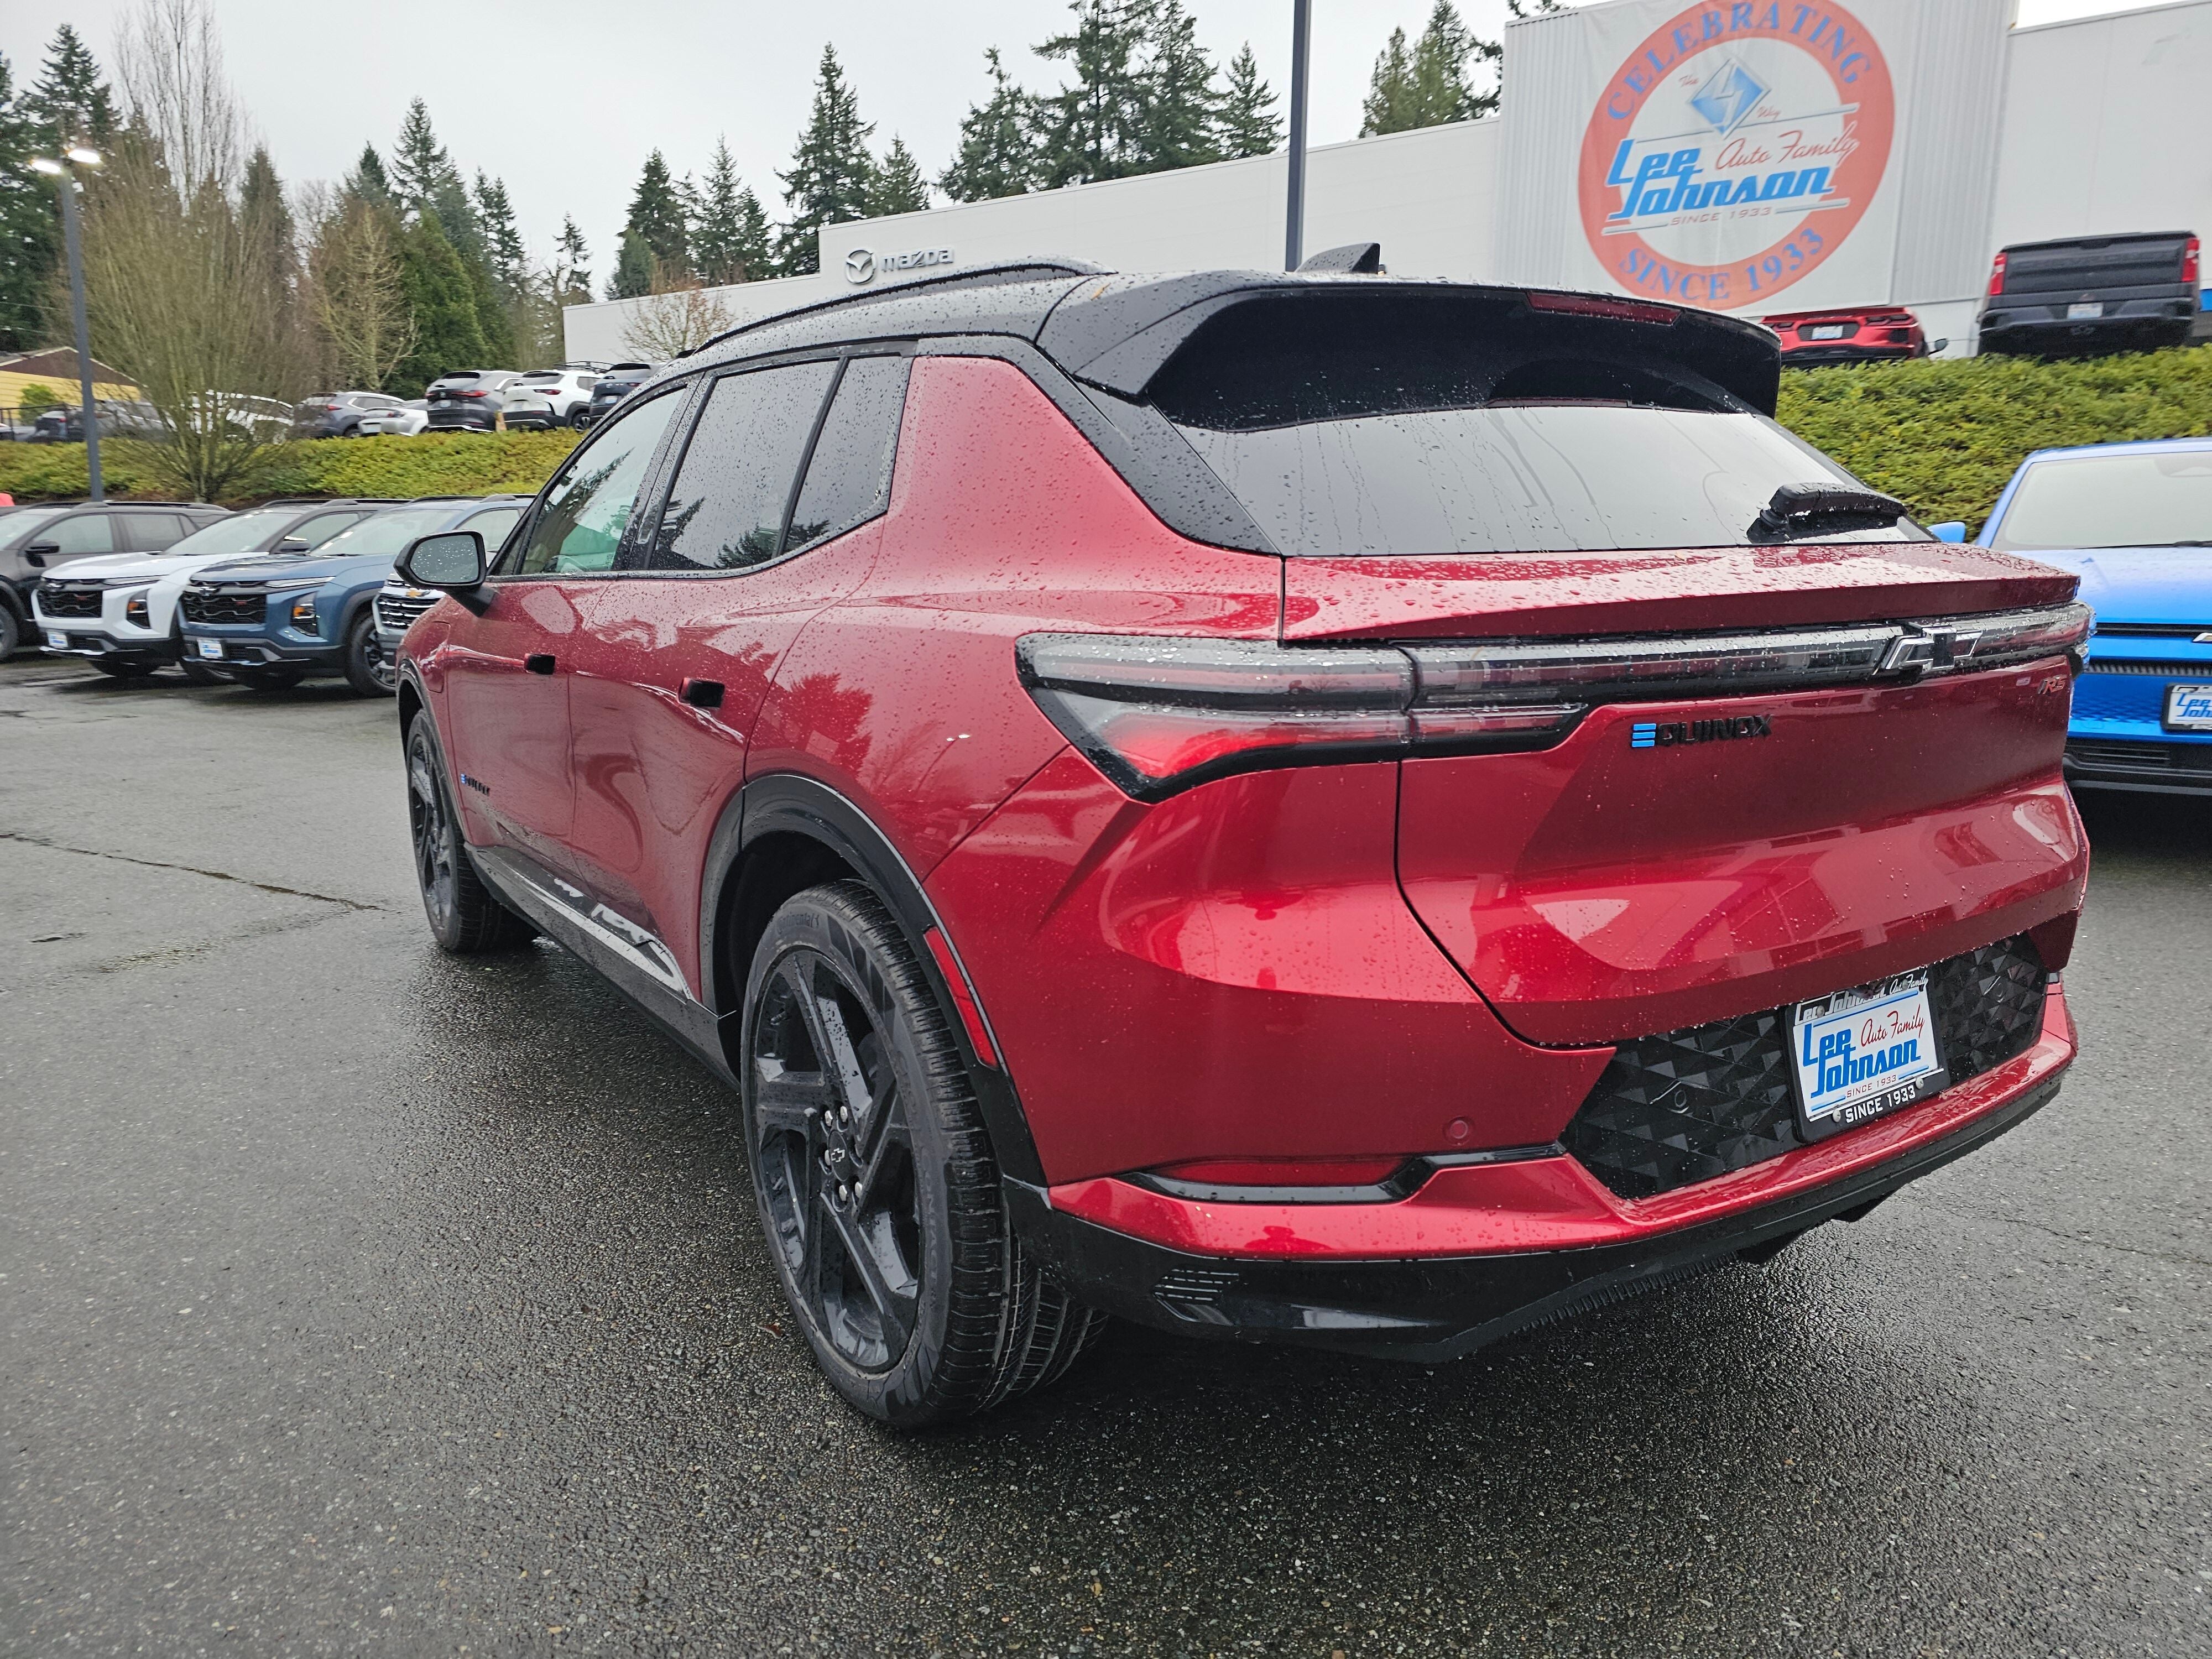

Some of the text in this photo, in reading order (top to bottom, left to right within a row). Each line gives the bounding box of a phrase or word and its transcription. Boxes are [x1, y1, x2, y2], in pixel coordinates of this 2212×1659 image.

[1607, 1, 1872, 120] CELEBRATING
[1608, 120, 1860, 185] Lee Auto Family
[1608, 165, 1837, 220] Johnson
[1670, 206, 1772, 226] SINCE 1933
[881, 248, 954, 272] mazda
[1619, 227, 1824, 300] SINCE 1933
[1632, 714, 1774, 747] EQUINOX
[1890, 979, 1907, 995] Aut
[1906, 970, 1929, 992] Family
[1803, 1004, 1926, 1067] Lee Auto Family
[1810, 1039, 1921, 1099] Johnson
[1846, 1074, 1897, 1098] SINCE 1933
[1845, 1085, 1916, 1124] SINCE 1933
